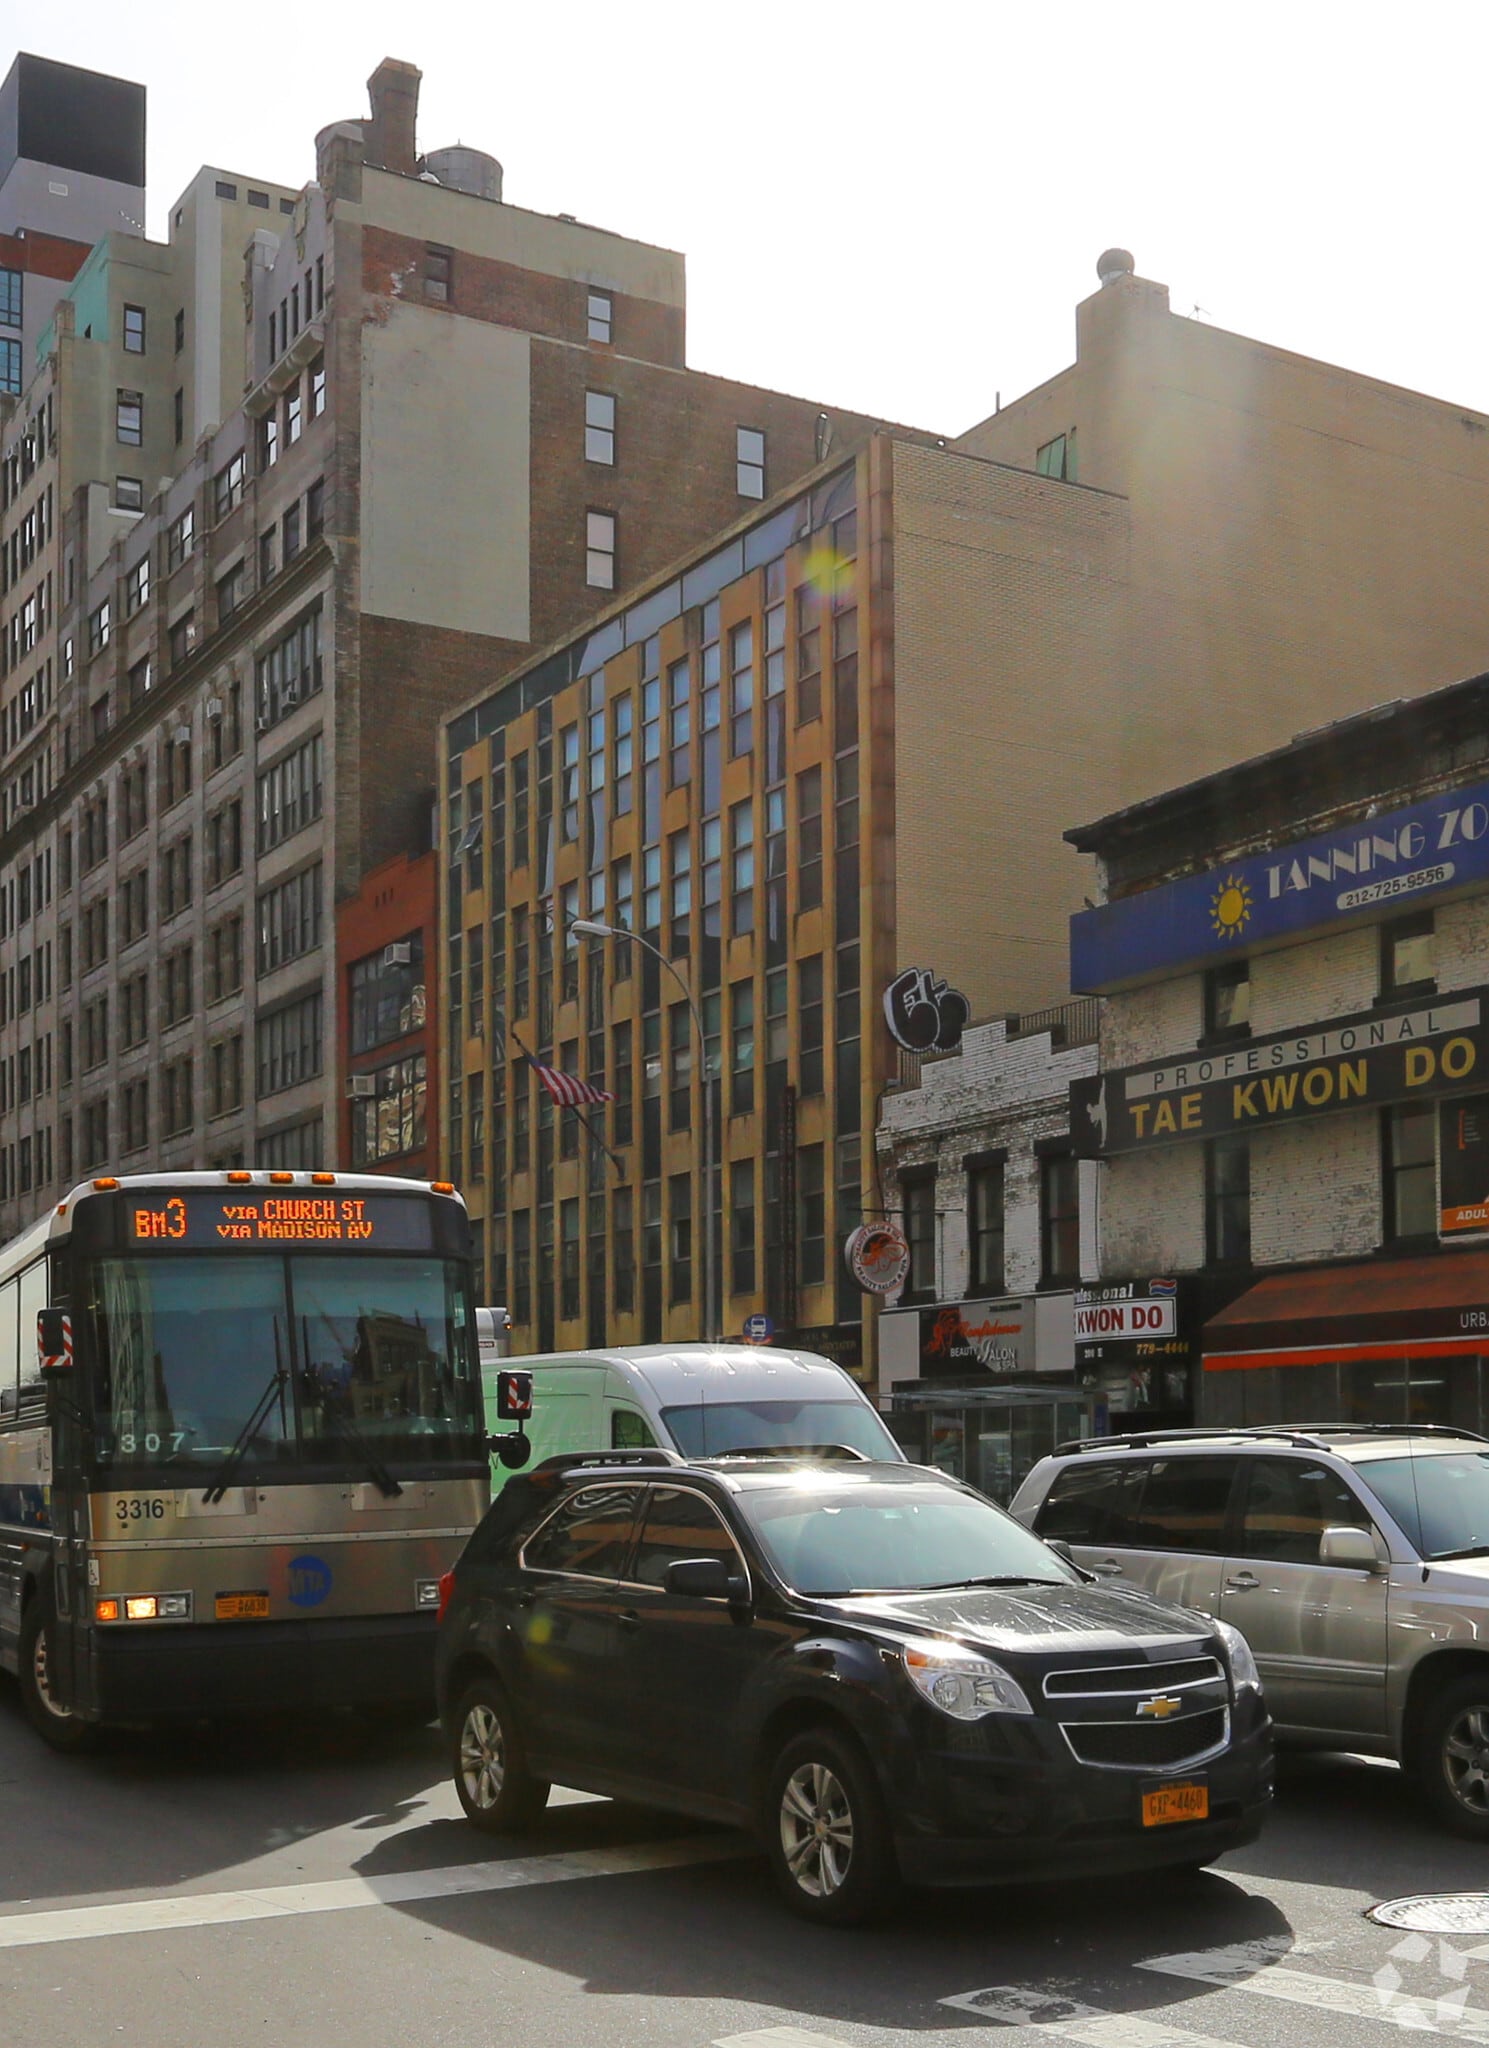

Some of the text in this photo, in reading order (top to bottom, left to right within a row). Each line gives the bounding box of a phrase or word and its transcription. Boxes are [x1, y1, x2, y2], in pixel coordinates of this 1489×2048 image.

[1264, 822, 1425, 899] TANNING
[1346, 866, 1445, 907] 212-725-9556
[1153, 1011, 1441, 1092] PROFESSIONAL
[1129, 1037, 1477, 1139] TAE KWON DO
[222, 1199, 365, 1221] VIA CHURCH ST
[216, 1221, 373, 1239] VIA MADISON AV
[1077, 1308, 1124, 1333] KWON
[1131, 1305, 1163, 1330] DO
[949, 1346, 977, 1358] BEAUTY
[116, 1498, 165, 1520] 3316
